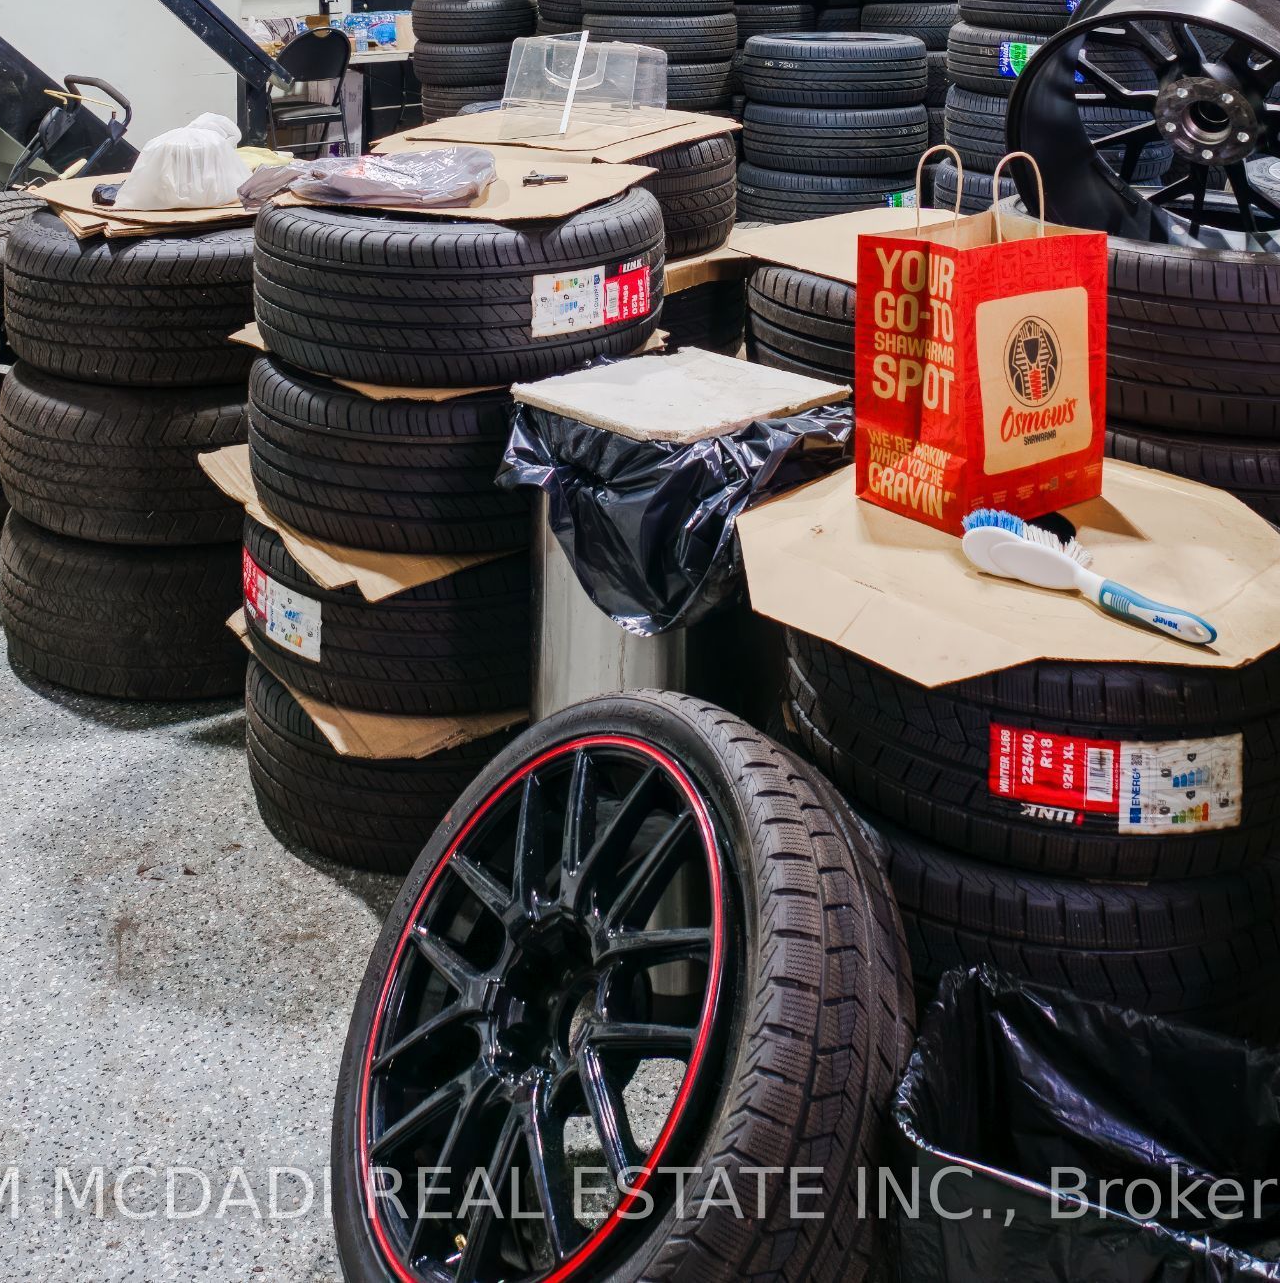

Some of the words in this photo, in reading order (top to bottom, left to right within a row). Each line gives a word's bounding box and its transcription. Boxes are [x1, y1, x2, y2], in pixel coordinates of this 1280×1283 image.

[875, 246, 955, 301] YOUR
[874, 290, 954, 343] GO-TO
[874, 331, 955, 368] SHAWARMA
[872, 354, 955, 415] SPOT
[867, 428, 913, 453] WE'RE
[1023, 429, 1057, 446] SHAWARMA
[869, 443, 907, 471] WHAT
[906, 454, 944, 488] YOU'RE
[868, 461, 957, 520] CRAVIN'
[1021, 733, 1035, 786] 225/40
[1039, 737, 1053, 769] R18
[1063, 742, 1075, 764] XL
[998, 755, 1011, 794] WINTER
[1062, 764, 1074, 790] 92H
